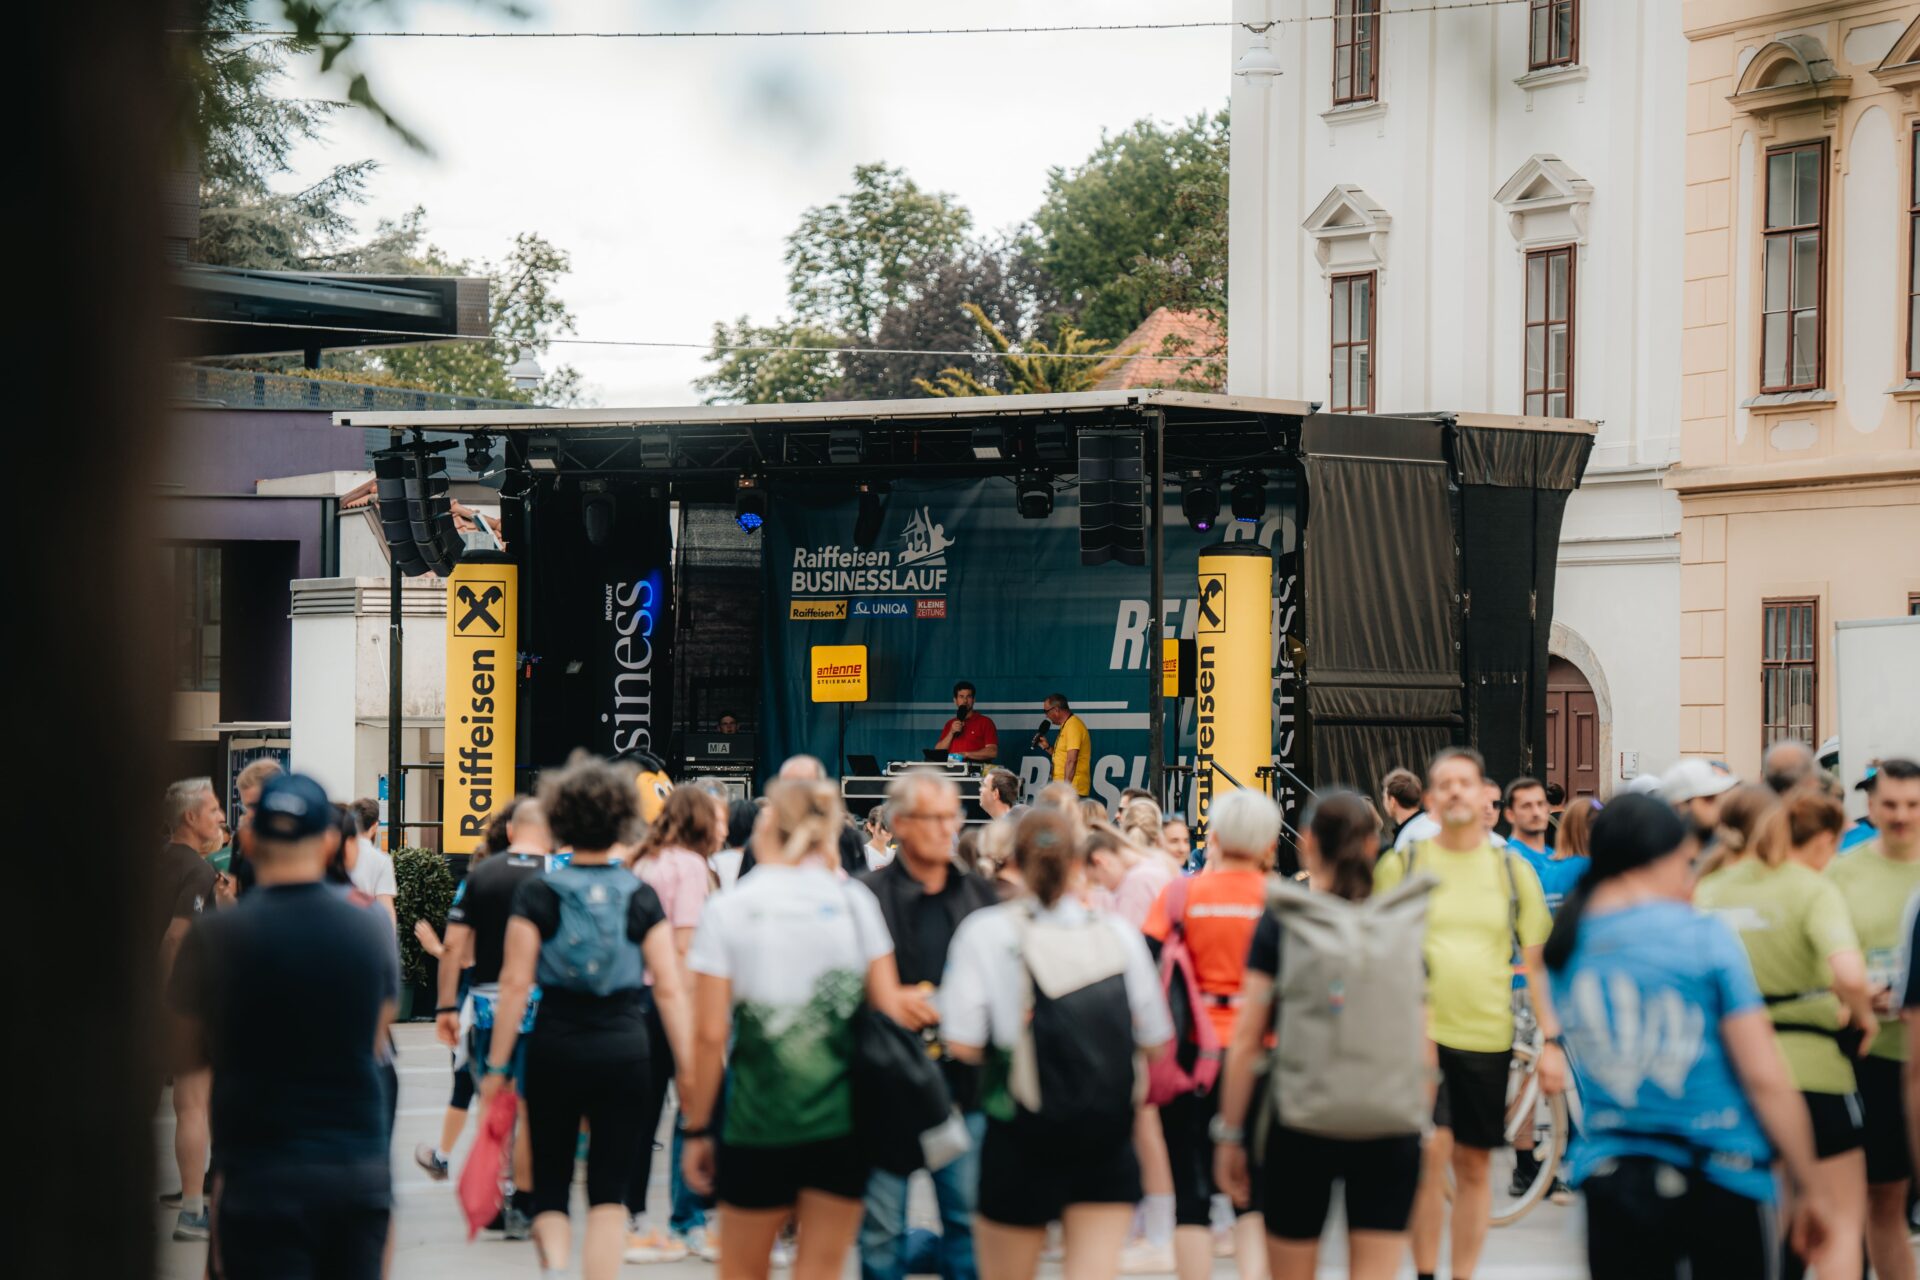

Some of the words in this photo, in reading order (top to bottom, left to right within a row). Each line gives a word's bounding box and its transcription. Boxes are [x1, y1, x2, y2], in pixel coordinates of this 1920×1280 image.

[793, 545, 890, 568] Raiffeisen
[791, 569, 947, 592] BUSINESSLAUF
[605, 583, 613, 621] MONAT
[793, 604, 834, 618] Raiffeisen
[872, 603, 908, 615] UNIQA
[918, 601, 945, 609] KLEINE
[917, 609, 945, 617] ZEITUNG
[601, 580, 653, 753] siness
[816, 663, 862, 675] antenne
[459, 649, 495, 837] Raiffeisen
